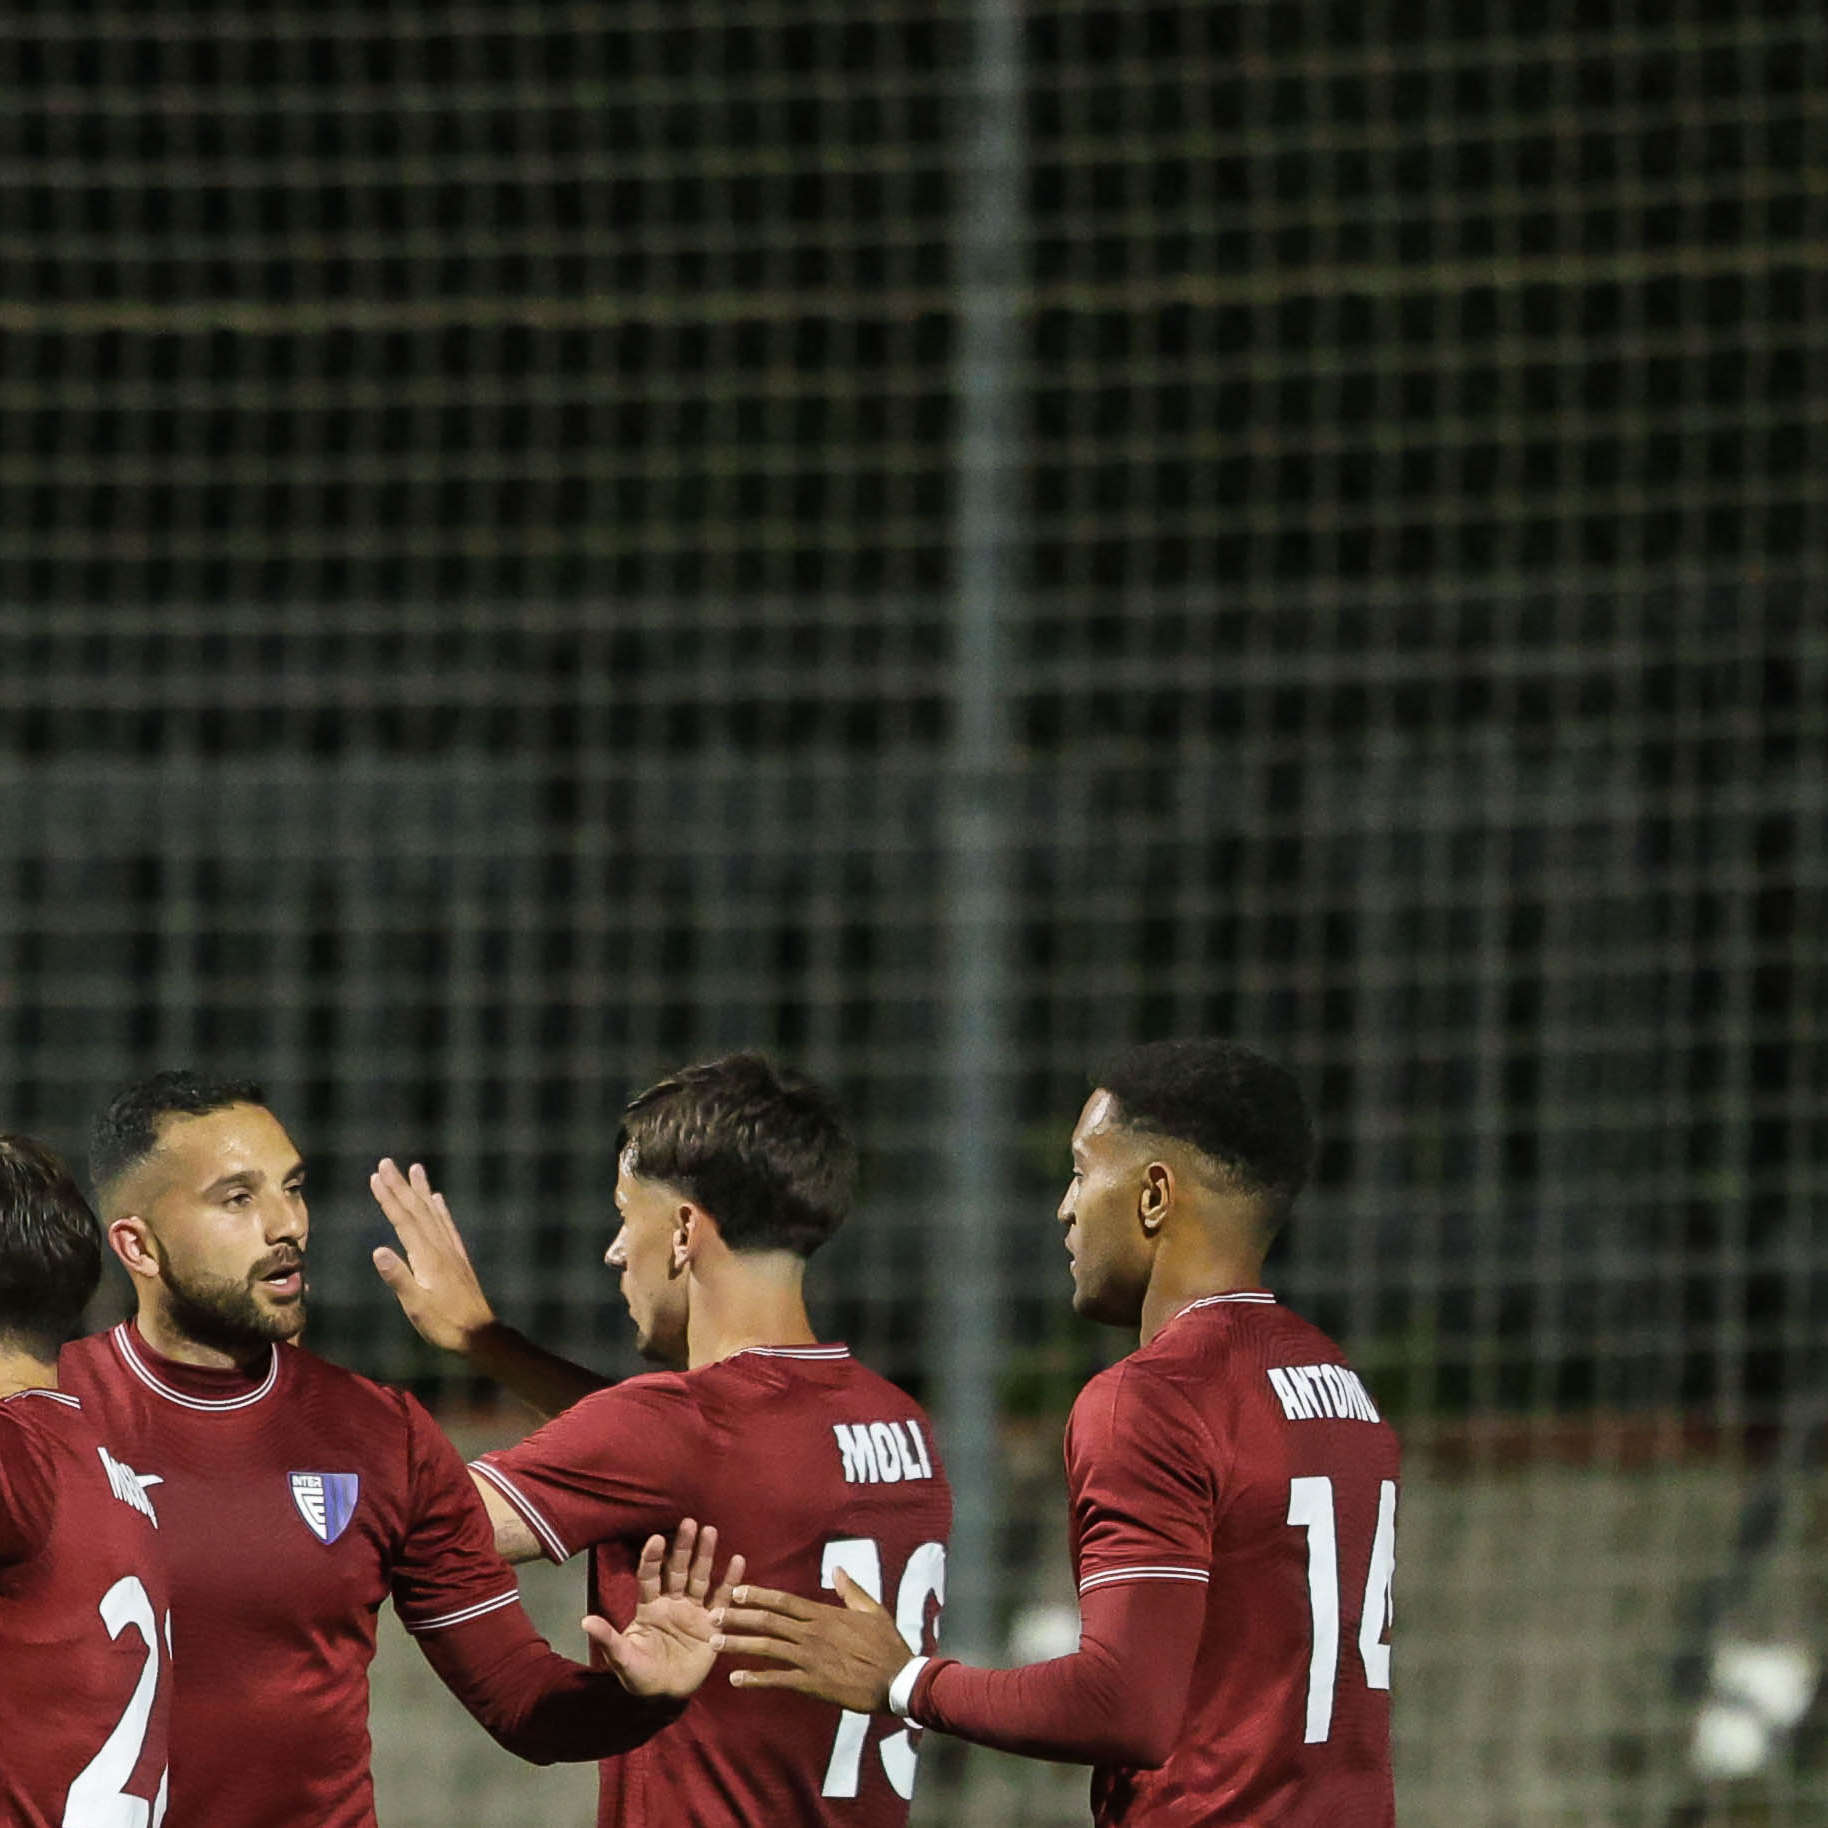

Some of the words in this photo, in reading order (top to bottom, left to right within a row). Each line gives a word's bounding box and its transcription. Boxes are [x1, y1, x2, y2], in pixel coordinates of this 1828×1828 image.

[291, 1474, 323, 1488] INTER
[833, 1420, 933, 1483] MOLI
[1287, 1476, 1396, 1743] 14
